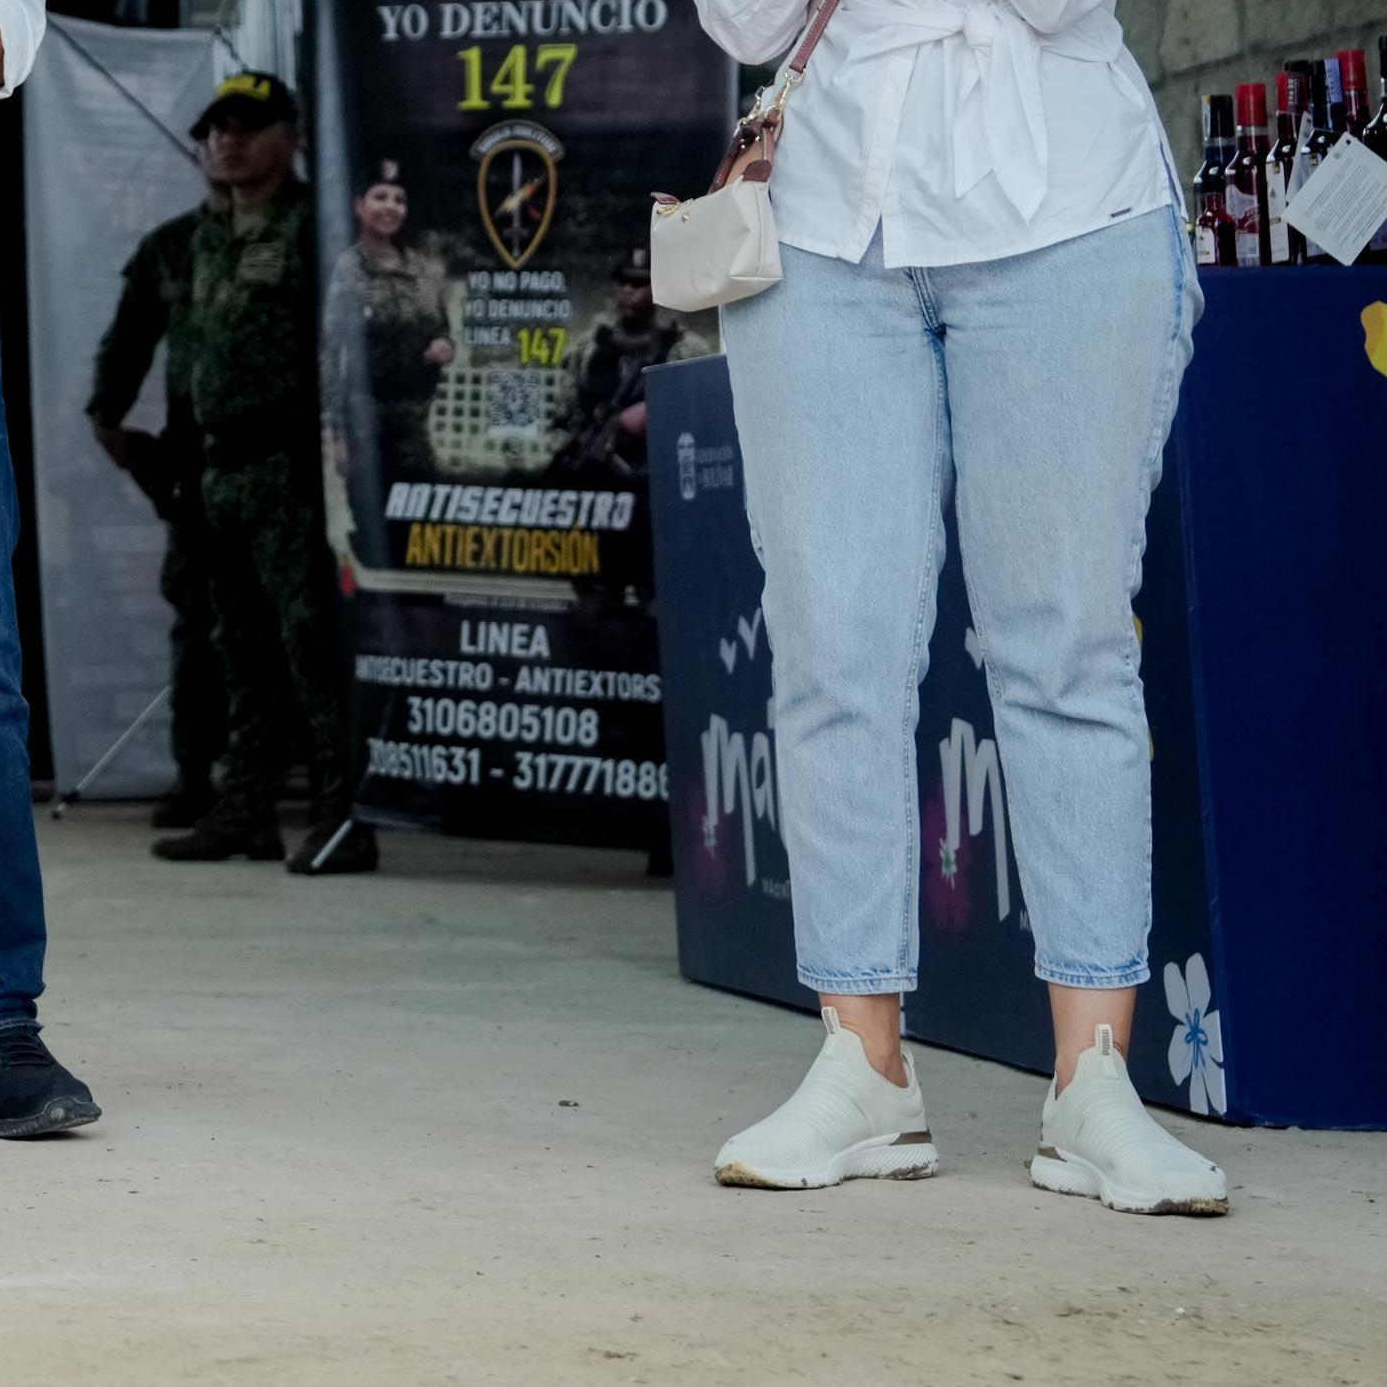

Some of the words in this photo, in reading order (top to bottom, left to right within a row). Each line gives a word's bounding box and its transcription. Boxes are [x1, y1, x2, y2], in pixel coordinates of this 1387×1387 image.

[377, 5, 427, 42] YO
[457, 43, 579, 111] 147
[488, 298, 573, 322] DENUNCIO
[517, 327, 569, 369] 147
[384, 481, 636, 531] ANTISECUESTRO
[459, 619, 551, 659] LINEA
[407, 695, 601, 748] 3106805108
